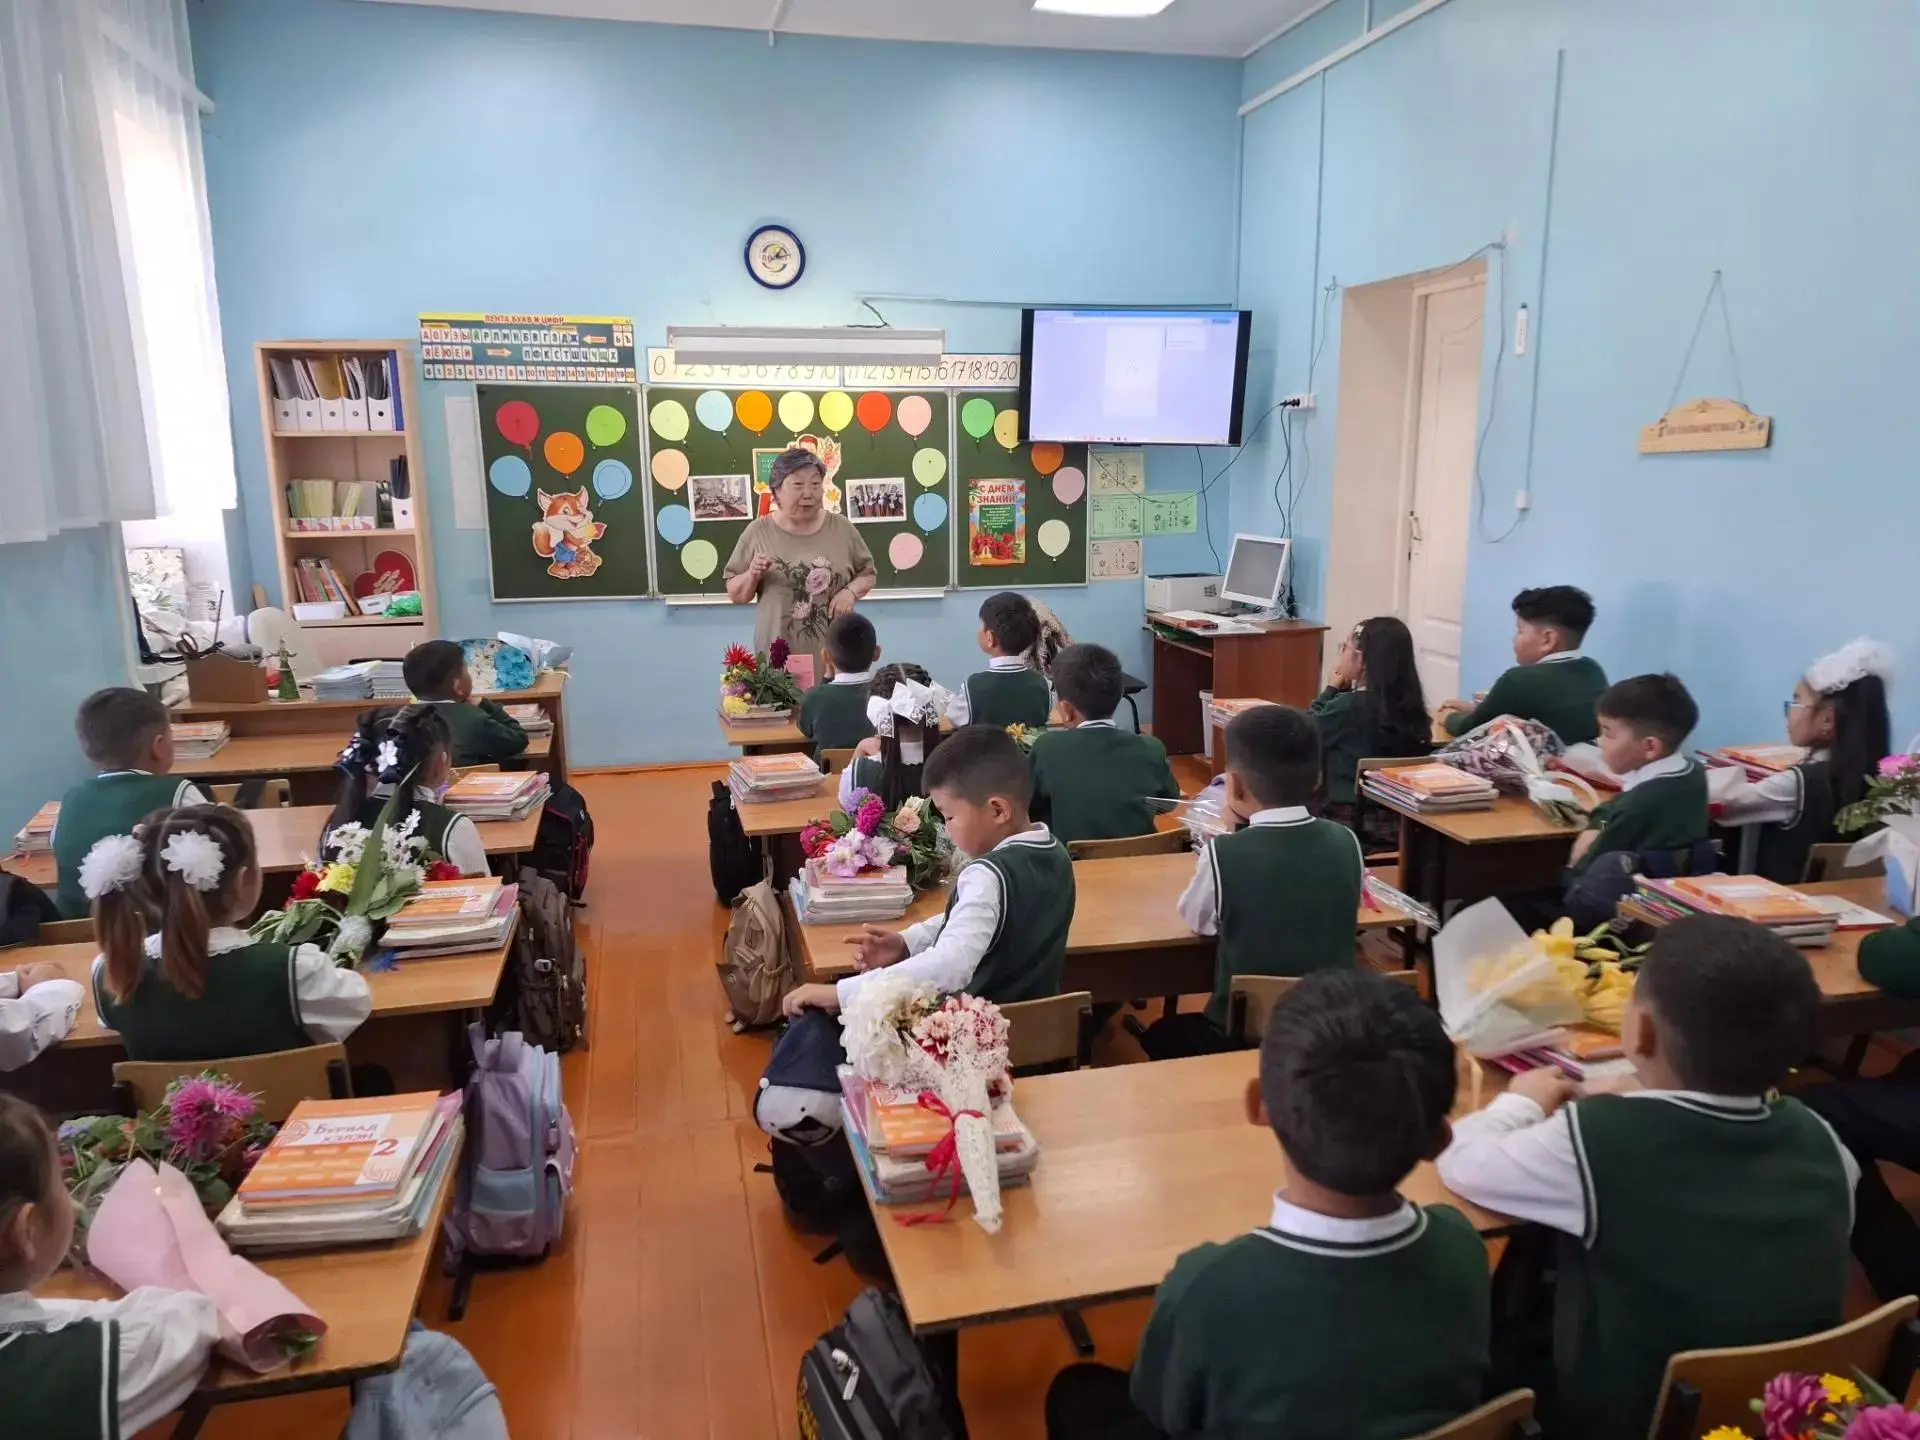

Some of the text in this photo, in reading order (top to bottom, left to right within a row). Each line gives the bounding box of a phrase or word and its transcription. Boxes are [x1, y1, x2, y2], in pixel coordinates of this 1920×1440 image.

[951, 360, 967, 380] 17
[968, 360, 982, 380] 18
[984, 360, 998, 380] 19
[1000, 360, 1018, 380] 20
[373, 1138, 399, 1156] 2
